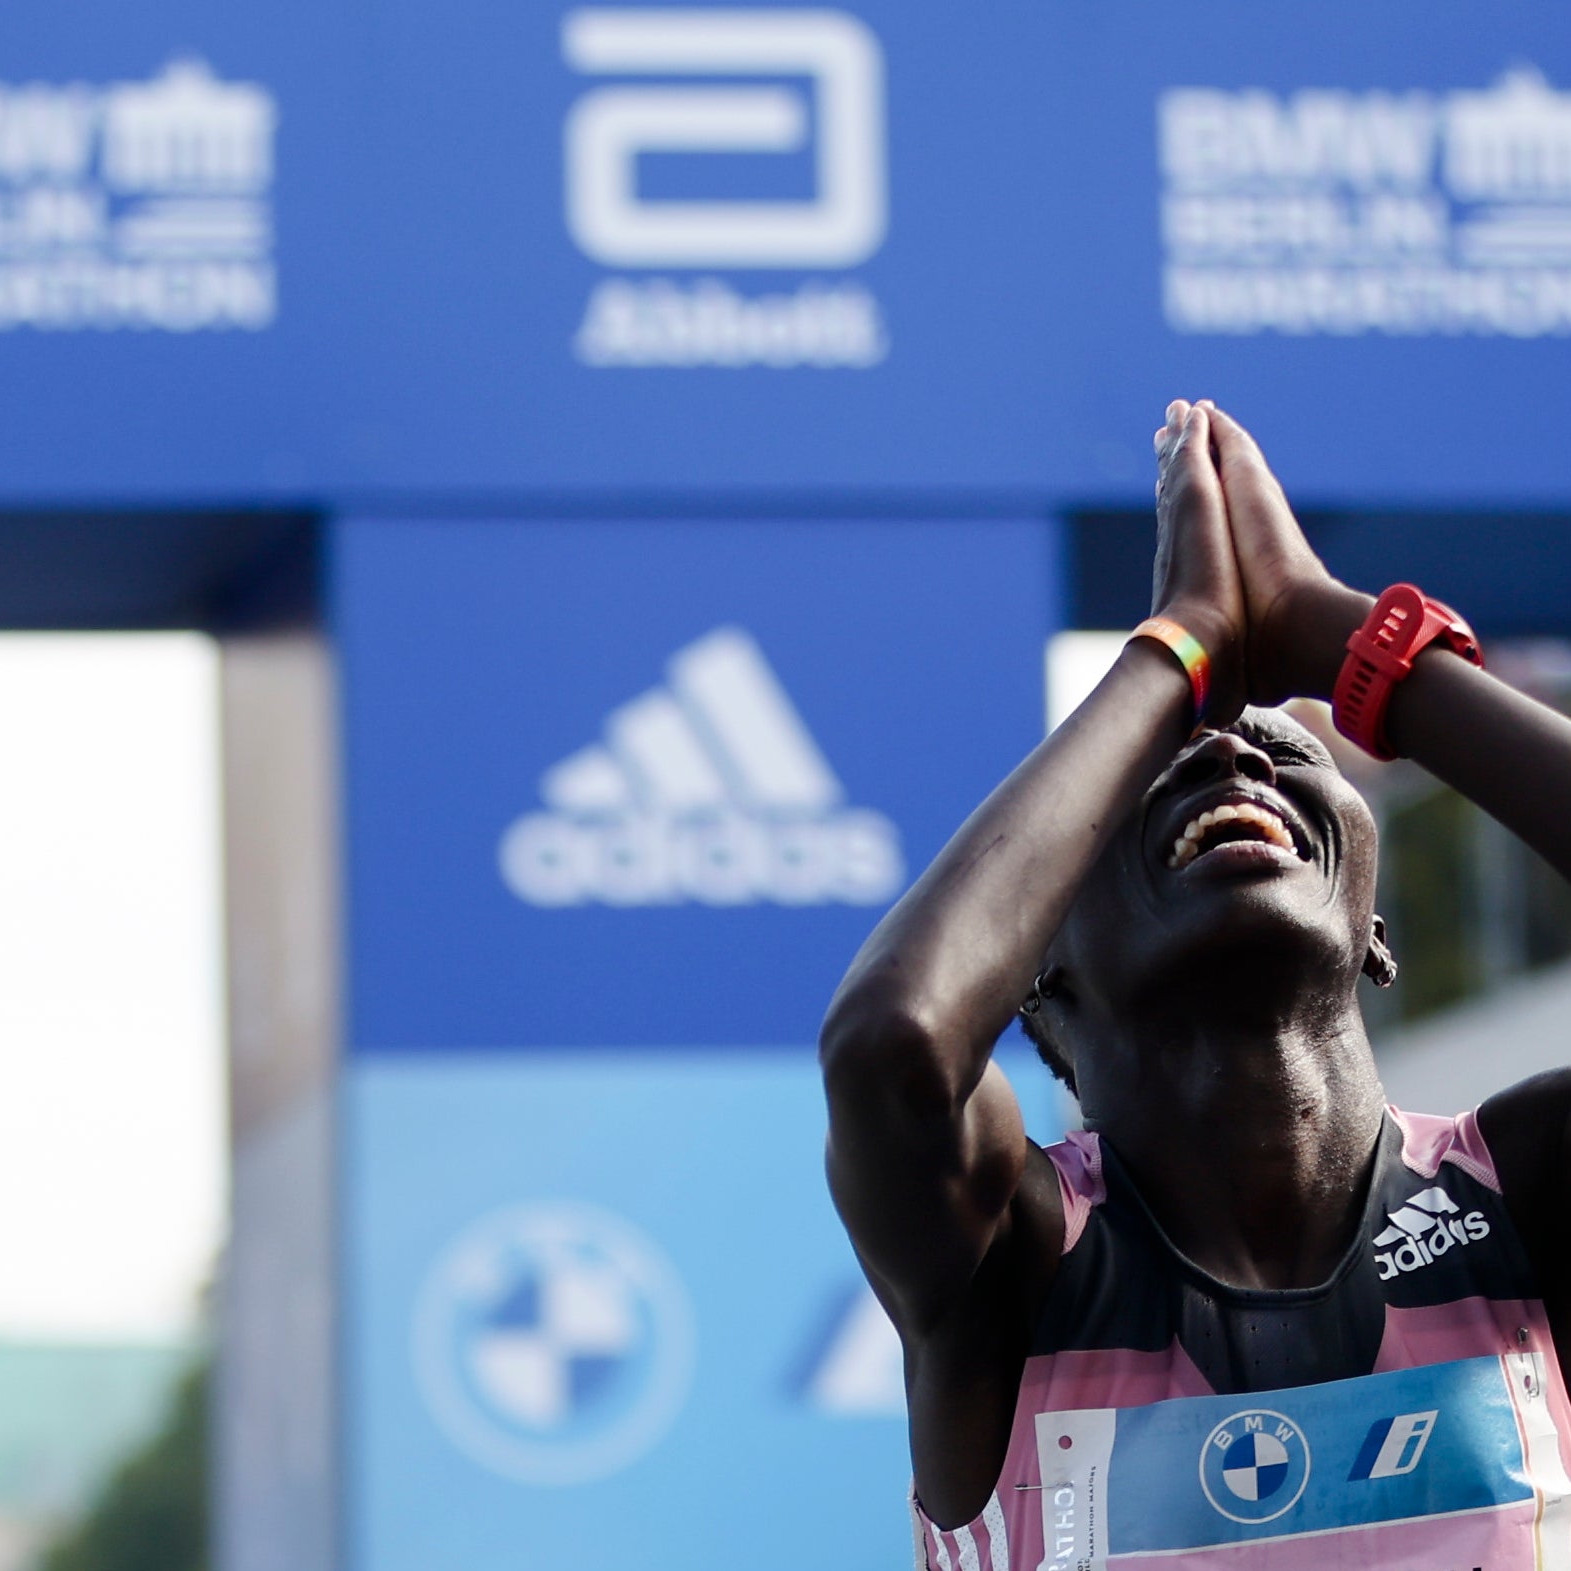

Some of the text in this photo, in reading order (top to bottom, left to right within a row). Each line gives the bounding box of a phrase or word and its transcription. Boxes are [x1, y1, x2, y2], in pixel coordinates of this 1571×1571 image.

[1158, 87, 1435, 189] BMW
[1160, 194, 1450, 264] BERLIN
[502, 808, 903, 905] adidas
[1213, 1416, 1294, 1450] BMW
